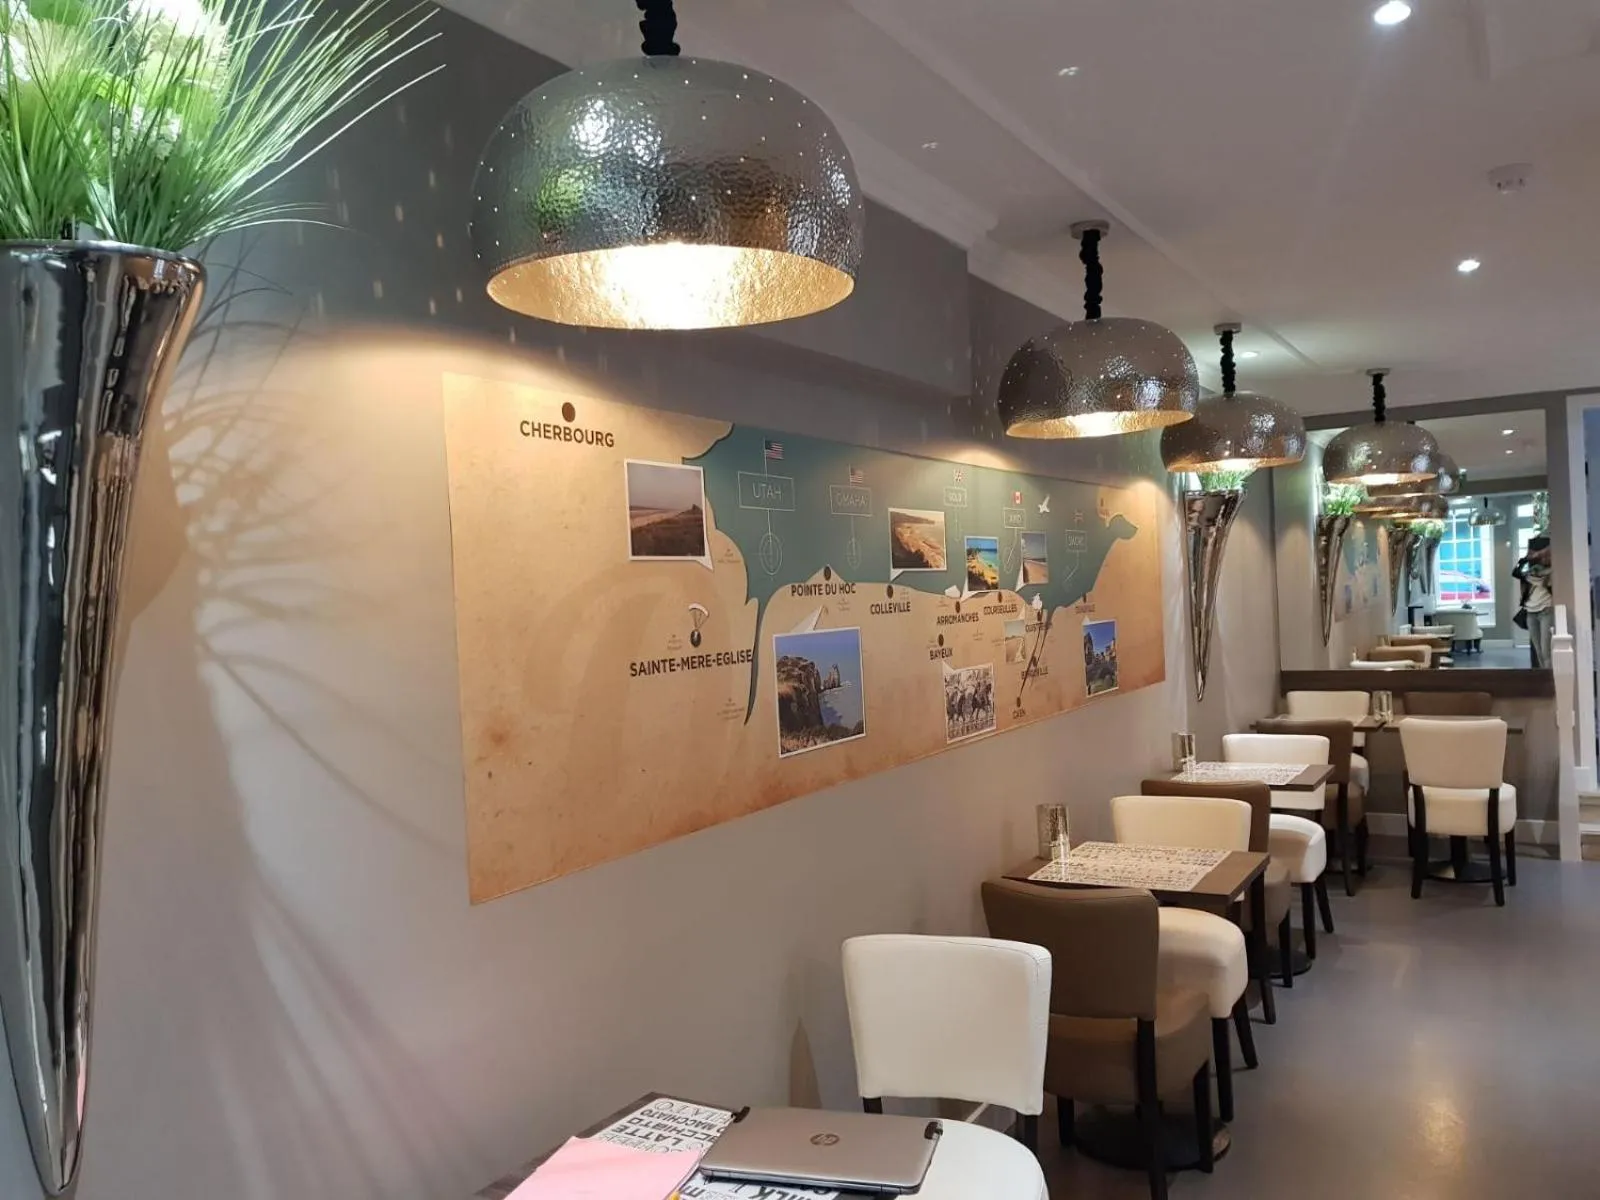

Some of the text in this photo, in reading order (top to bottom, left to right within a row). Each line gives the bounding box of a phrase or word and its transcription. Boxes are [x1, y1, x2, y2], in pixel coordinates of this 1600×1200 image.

[520, 420, 615, 448] CHERBOURG
[752, 482, 782, 501] UTAH
[791, 582, 856, 596] POINTE DU HOC
[870, 601, 911, 615] COLLEVILLE
[936, 612, 980, 626] ARROMANCHES
[630, 649, 753, 677] SAINTE-MERE-EGLISE
[929, 648, 953, 661] BAYEUX
[640, 1109, 717, 1131] MACCHIATO
[611, 1124, 684, 1146] LATTE
